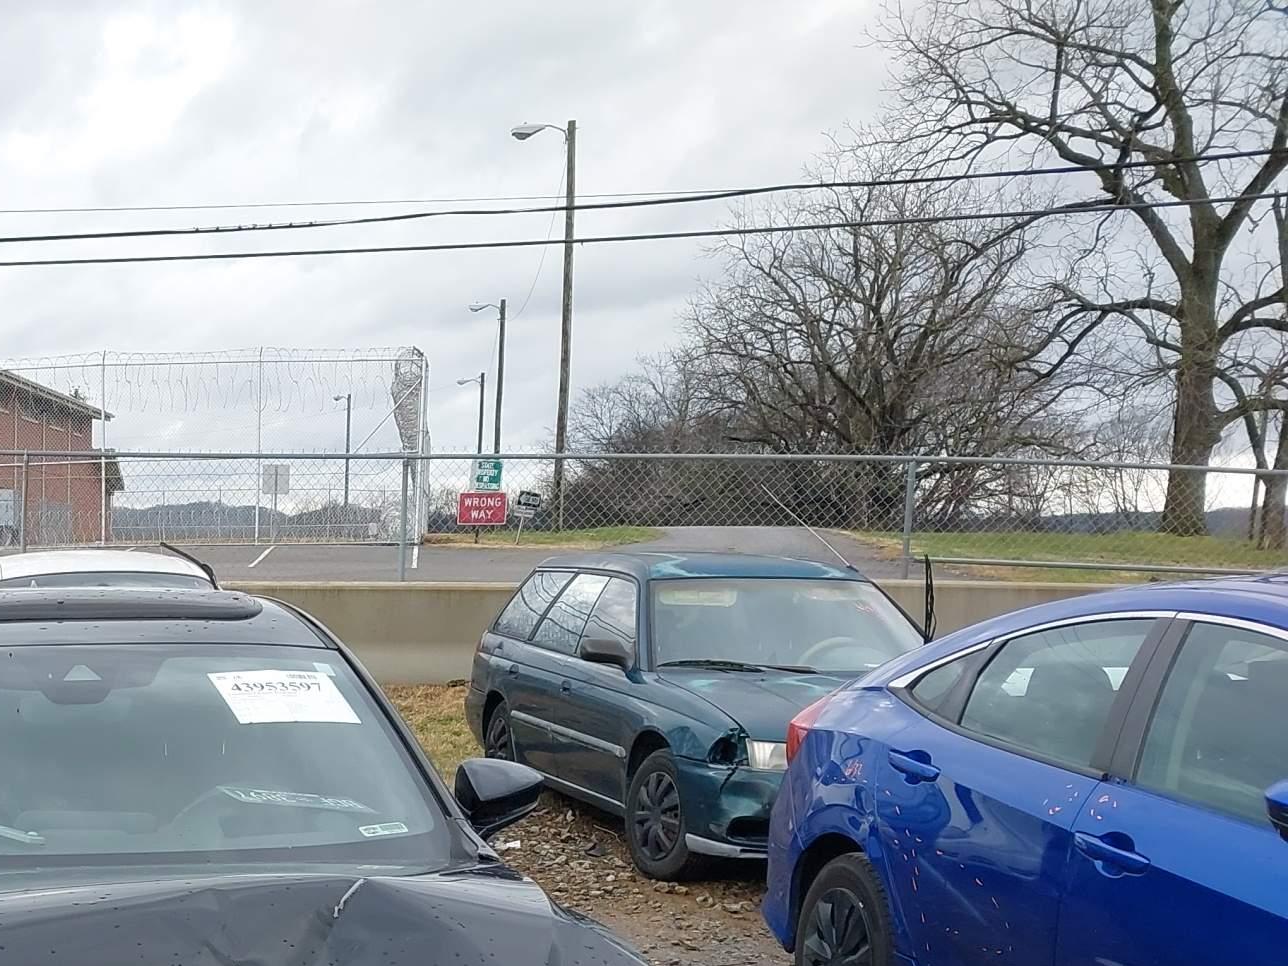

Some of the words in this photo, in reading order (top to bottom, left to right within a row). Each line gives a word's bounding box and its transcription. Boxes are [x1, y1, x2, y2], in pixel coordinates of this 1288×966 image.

[464, 497, 502, 507] WRONG
[471, 510, 494, 519] WAY
[231, 681, 321, 693] 43953597
